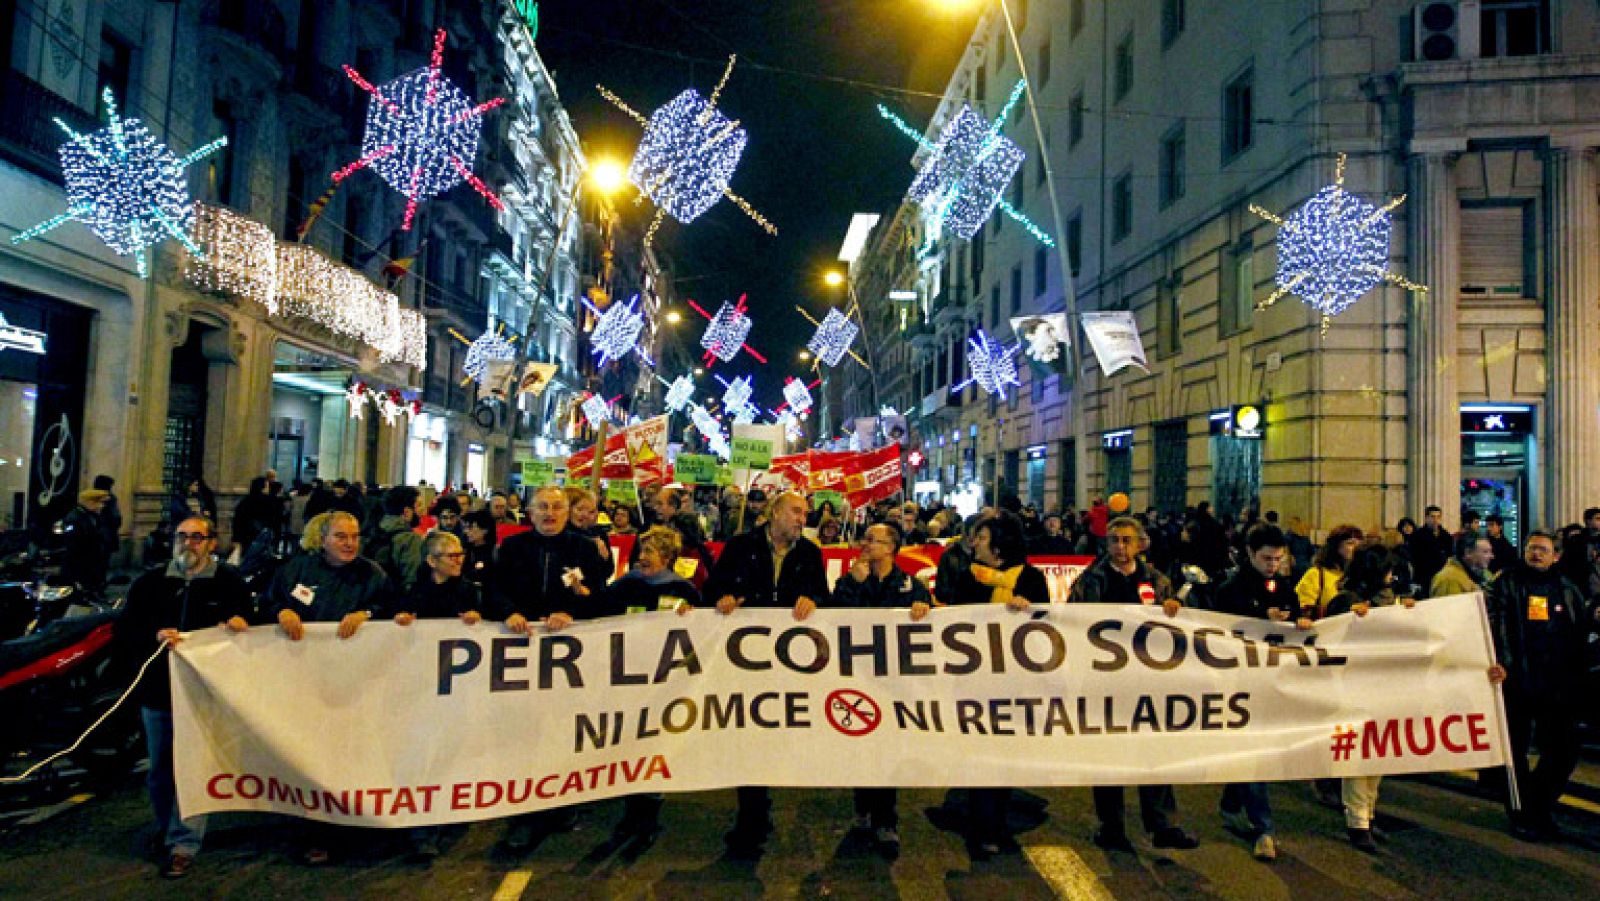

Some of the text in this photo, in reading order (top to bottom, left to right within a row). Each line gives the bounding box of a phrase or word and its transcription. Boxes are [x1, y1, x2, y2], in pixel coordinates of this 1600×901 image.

[437, 610, 1348, 695] PER LA COHESIÓ SOCIAL
[574, 692, 811, 753] NI LOMCE
[893, 692, 1251, 737] NI RETALLADES
[1330, 713, 1490, 761] #MUCE
[206, 754, 671, 817] COMUNITAT EDUCATIVA
